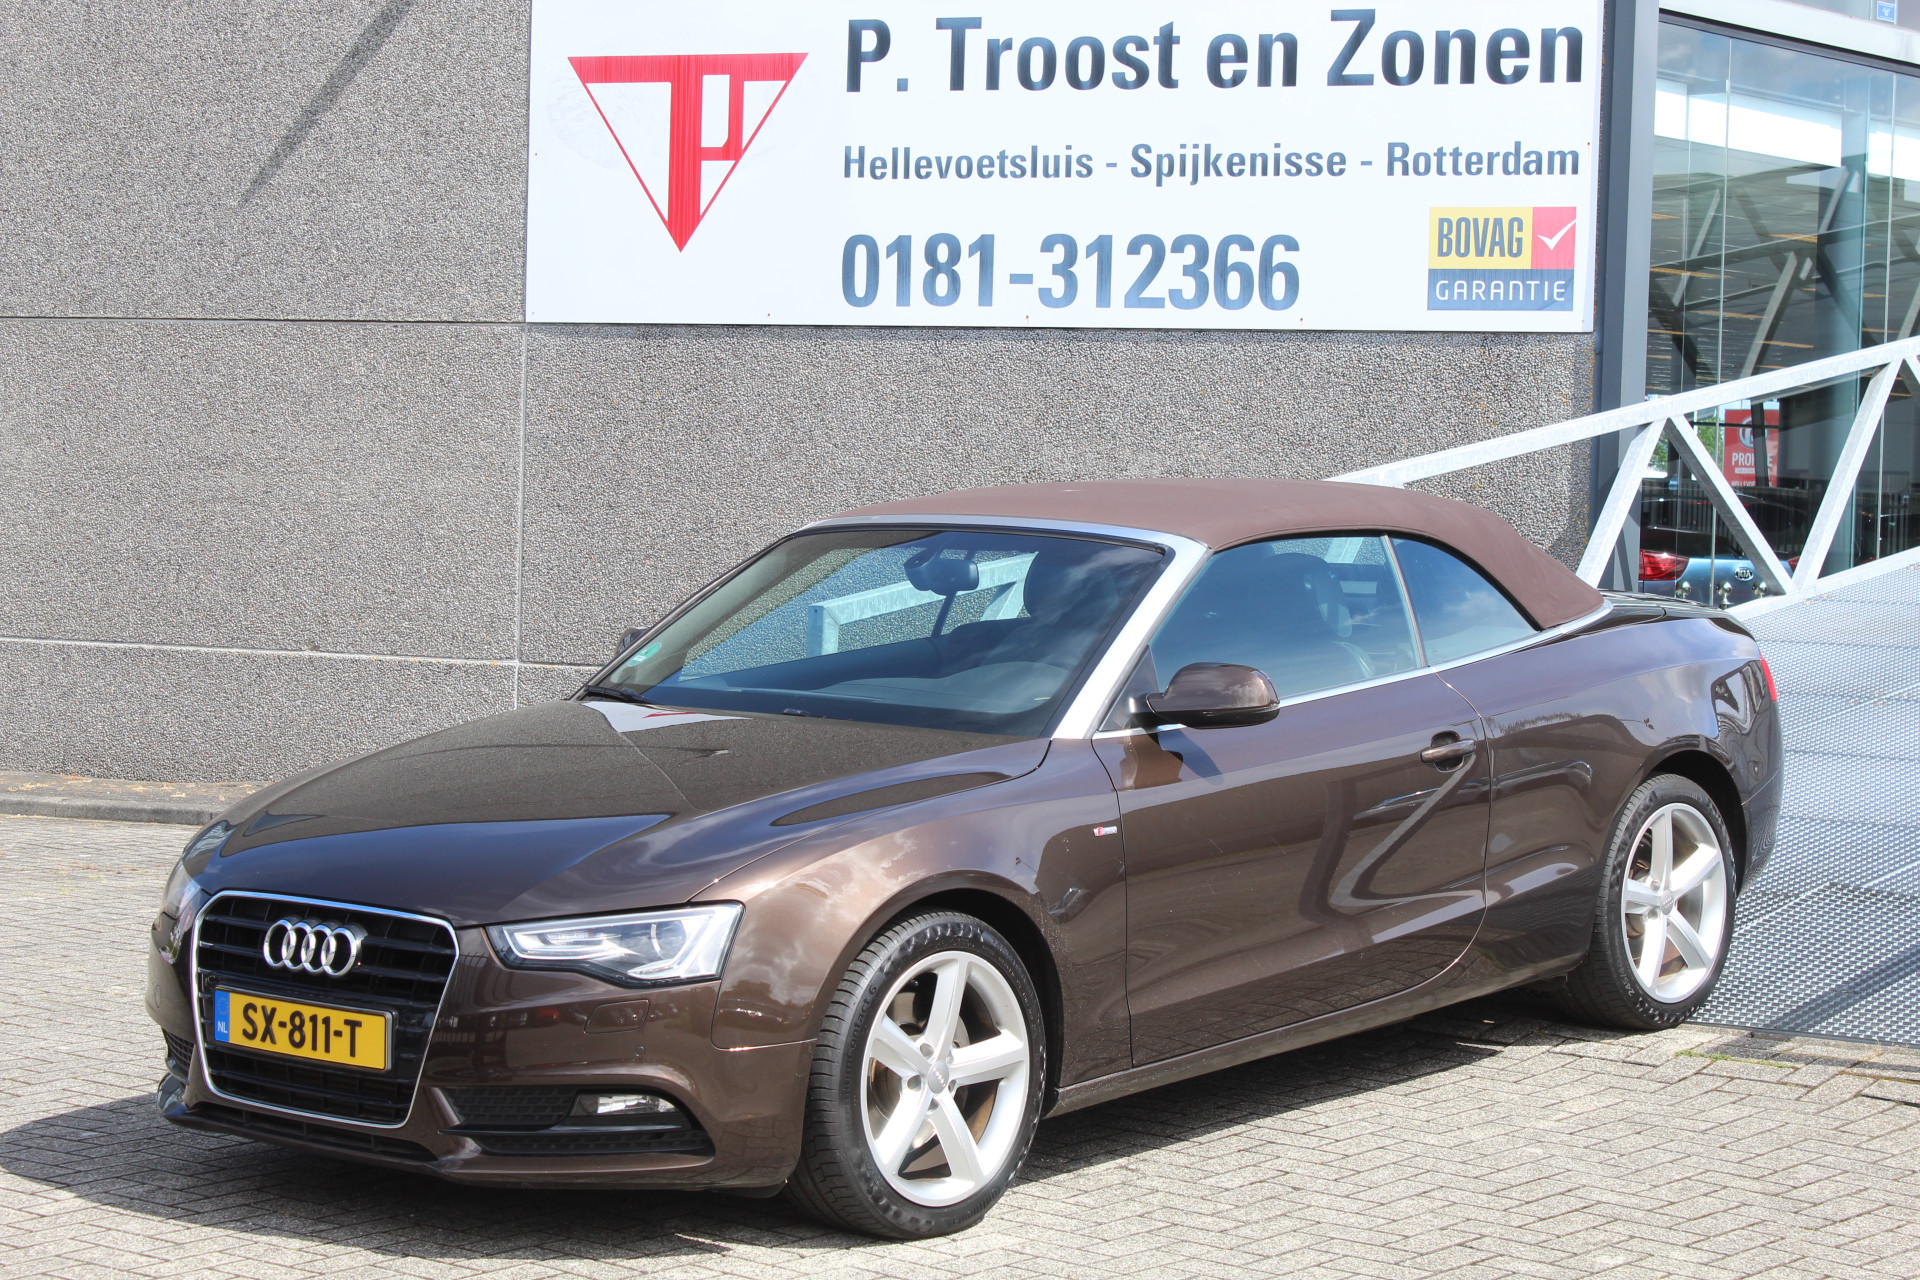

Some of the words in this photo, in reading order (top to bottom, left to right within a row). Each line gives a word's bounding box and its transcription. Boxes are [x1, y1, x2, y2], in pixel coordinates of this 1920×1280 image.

[847, 19, 909, 92] P.
[936, 17, 1181, 91] Troost
[1206, 32, 1299, 89] en
[1326, 9, 1583, 87] Zonen
[844, 145, 1093, 180] Hellevoetsluis
[1130, 143, 1347, 188] Spijkenisse
[1387, 141, 1580, 177] Rotterdam
[1437, 216, 1524, 258] BOVAG
[841, 232, 1300, 311] 0181-312366
[1435, 280, 1567, 302] GARANTIE
[217, 1021, 228, 1034] NL
[242, 1002, 362, 1058] SX-811-T
